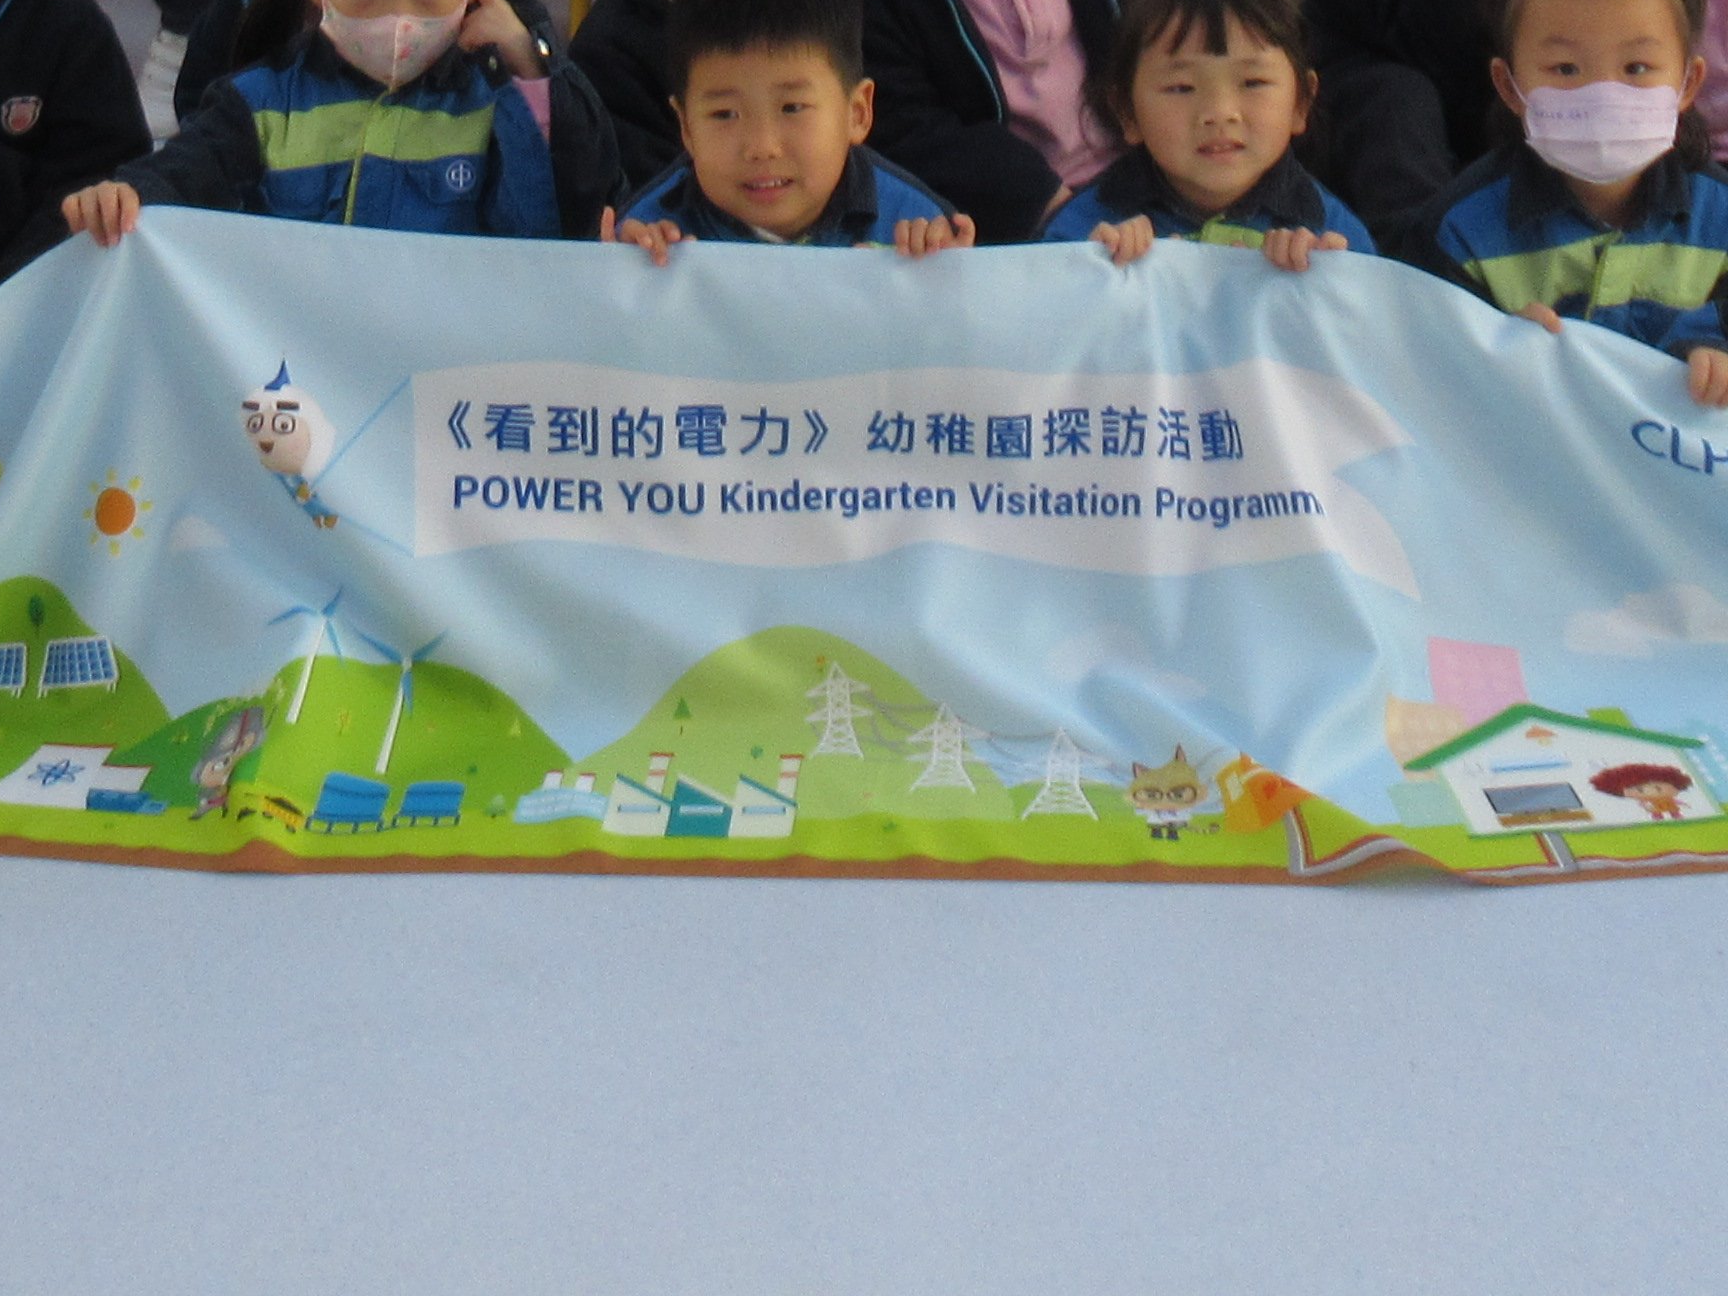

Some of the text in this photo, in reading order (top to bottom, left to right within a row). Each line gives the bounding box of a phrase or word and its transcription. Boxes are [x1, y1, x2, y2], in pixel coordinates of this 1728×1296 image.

[447, 401, 1244, 462] 《看到的電力》 幼稚園探訪活動
[453, 475, 603, 512] POWER
[619, 480, 705, 514] YOU
[721, 480, 956, 518] Kindergarten
[969, 482, 1141, 517] Visitation
